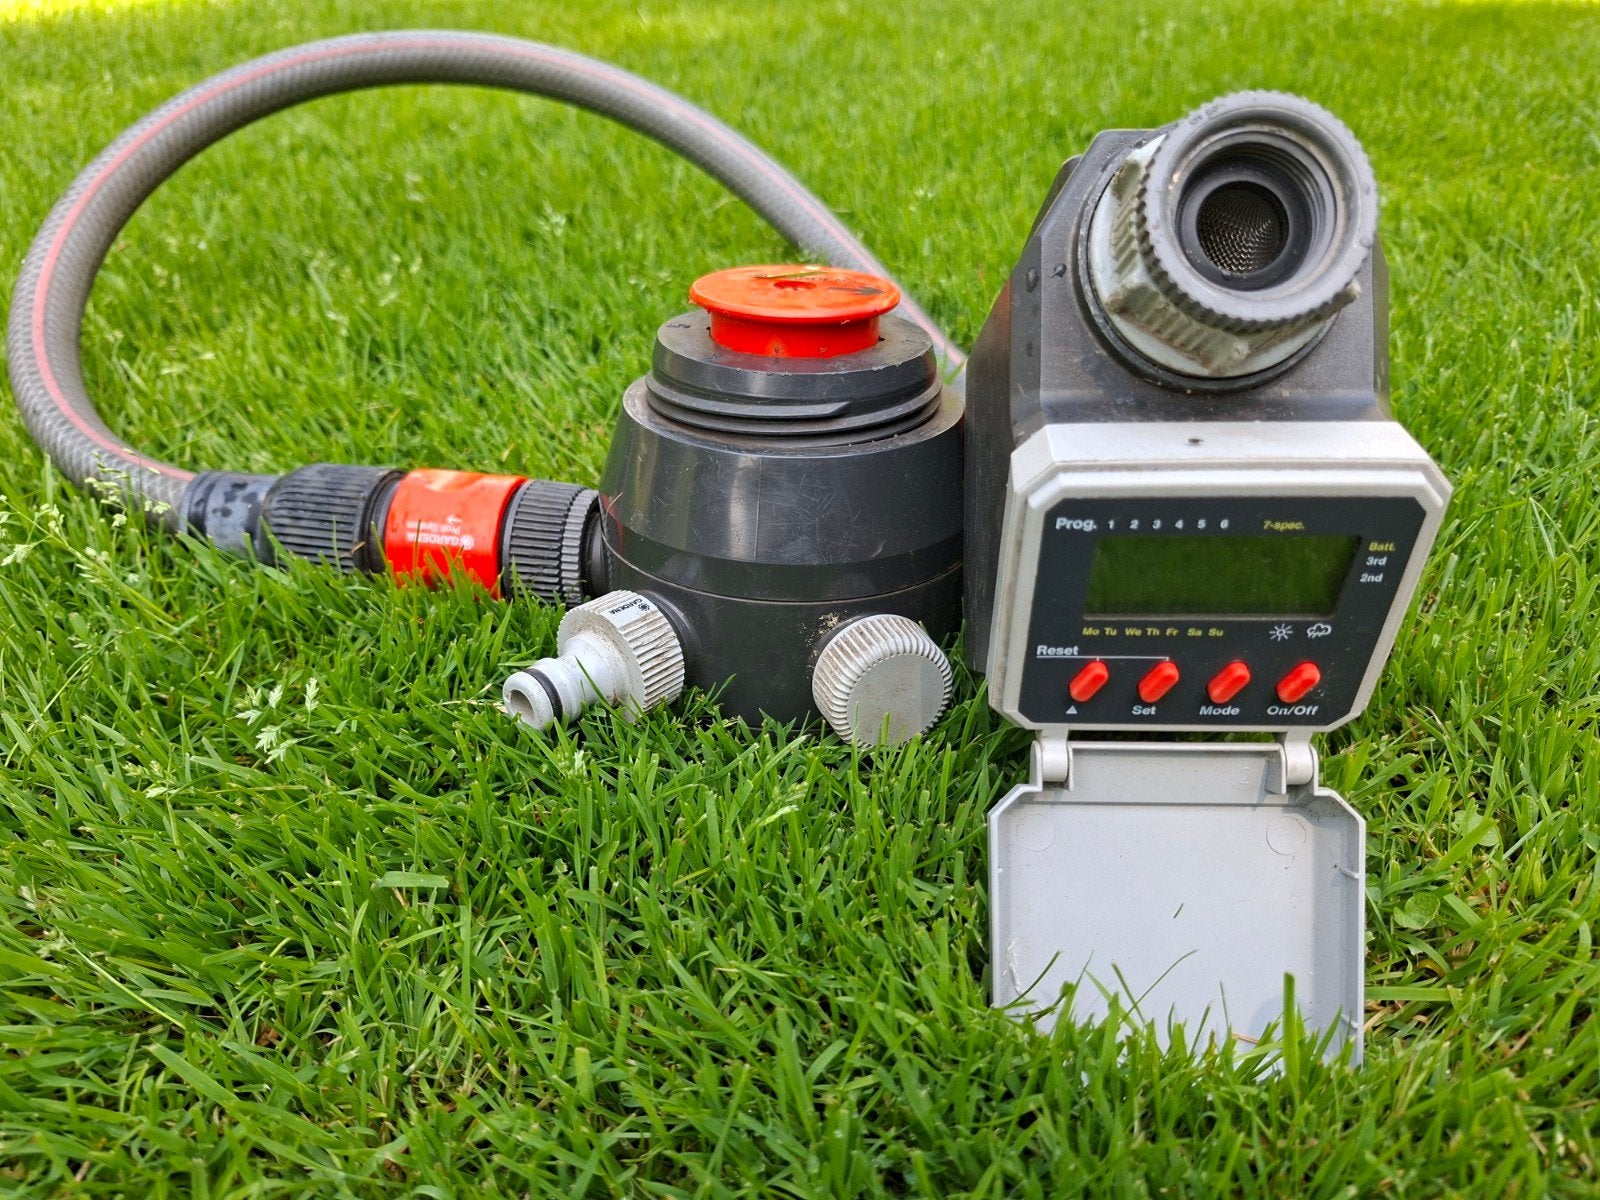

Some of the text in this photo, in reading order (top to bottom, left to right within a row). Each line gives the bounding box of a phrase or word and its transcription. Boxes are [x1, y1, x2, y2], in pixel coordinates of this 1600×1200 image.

[1055, 517, 1229, 532] Prog. 1 2 3 4 5 6
[1368, 541, 1396, 552] Batt.
[1366, 556, 1387, 566] 3rd
[1359, 573, 1384, 583] 2nd
[1082, 627, 1224, 637] Mo Tu We Th Fr Sa Su
[1036, 644, 1079, 656] Reset
[1131, 705, 1157, 715] Set
[1199, 705, 1240, 716] Mode
[1266, 705, 1319, 716] On/Off
